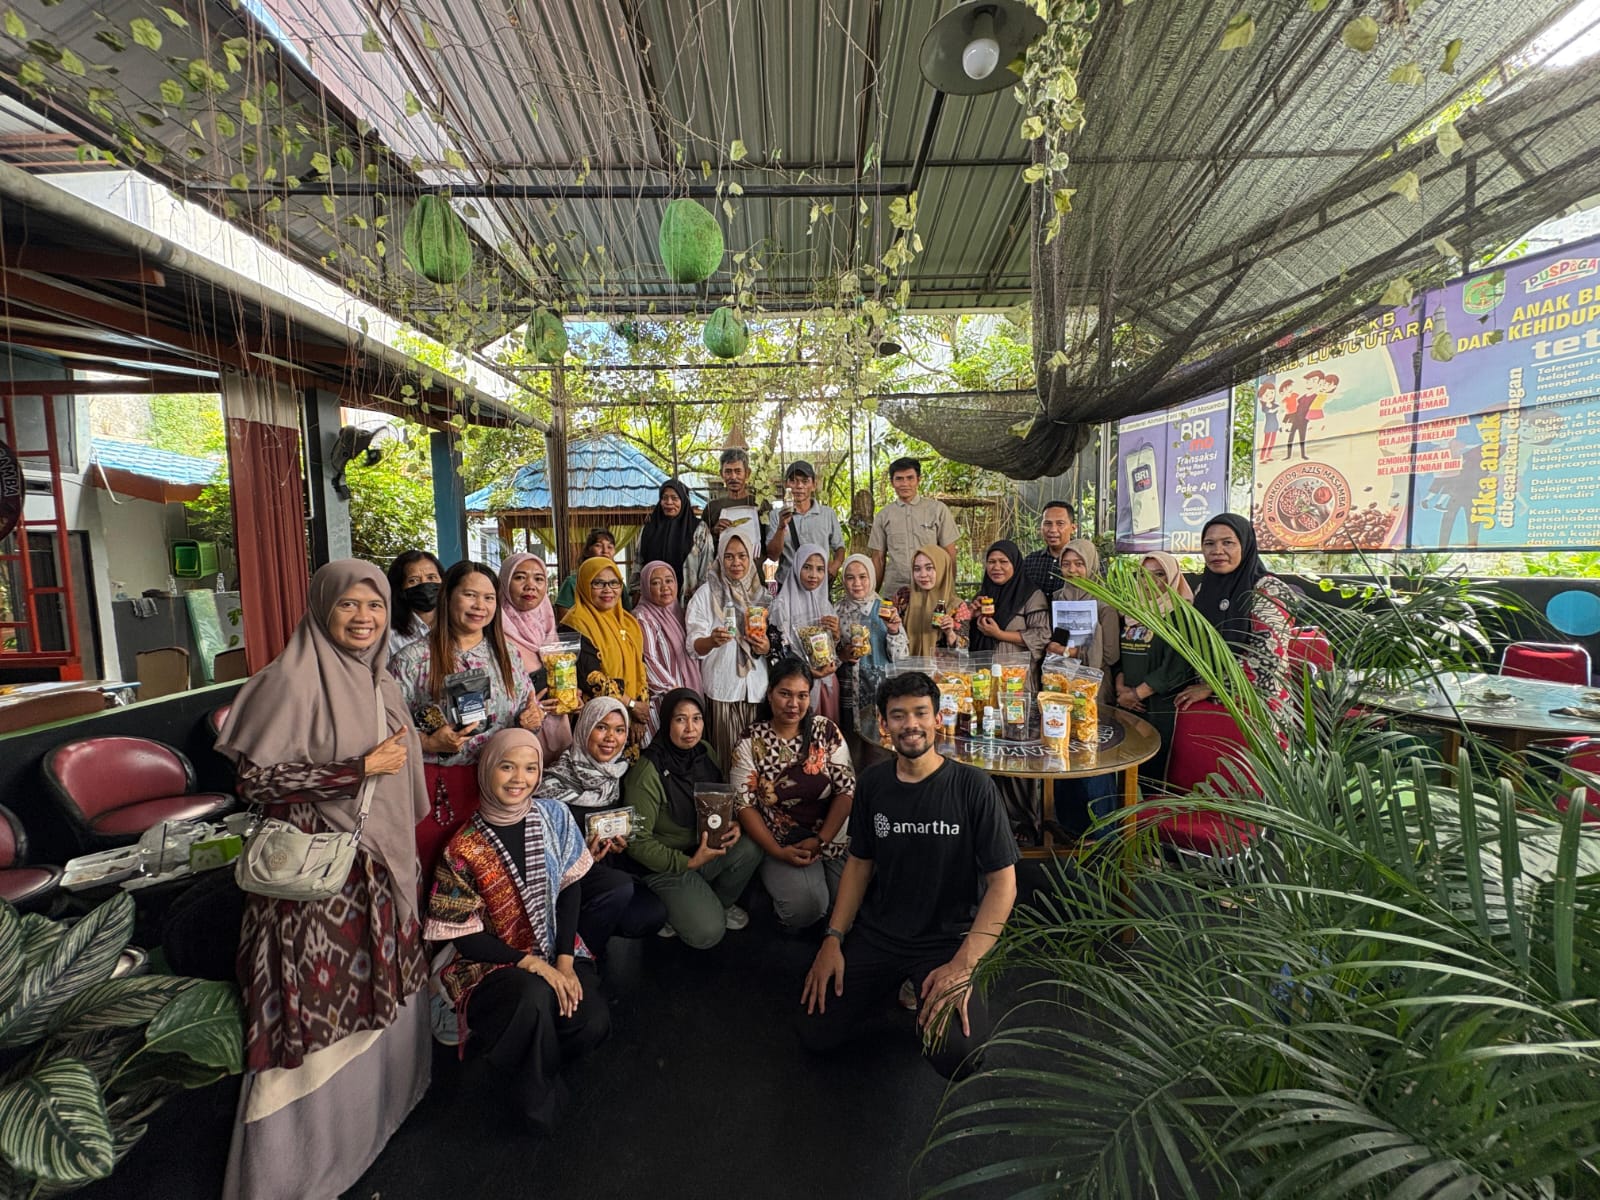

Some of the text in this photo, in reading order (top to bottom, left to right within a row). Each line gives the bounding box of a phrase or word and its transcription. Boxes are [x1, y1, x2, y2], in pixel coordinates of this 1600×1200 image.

[1511, 293, 1572, 323] ANAK
[1365, 316, 1434, 350] UTARA
[1457, 305, 1600, 353] DAR KEHIDUP
[1537, 358, 1593, 375] Toleransi
[1537, 370, 1581, 383] belajar
[1379, 404, 1412, 417] BELAJAR
[1535, 416, 1571, 426] Pujian
[1180, 418, 1210, 441] BRI
[1379, 435, 1410, 447] BELAJAR
[1498, 368, 1526, 528] dibesarkan dengan
[1377, 465, 1409, 476] BELAJAR
[1471, 412, 1501, 529] Jika anak
[1531, 475, 1594, 486] Dukungan
[1176, 481, 1217, 494] Pake Aja
[1267, 479, 1283, 513] WARKOP
[1302, 466, 1321, 474] AZIS
[1323, 471, 1346, 508] MASAMBA
[1530, 485, 1572, 493] belajar
[1553, 490, 1594, 500] sendiri
[1529, 507, 1561, 515] Kasih
[893, 820, 960, 835] amartha
